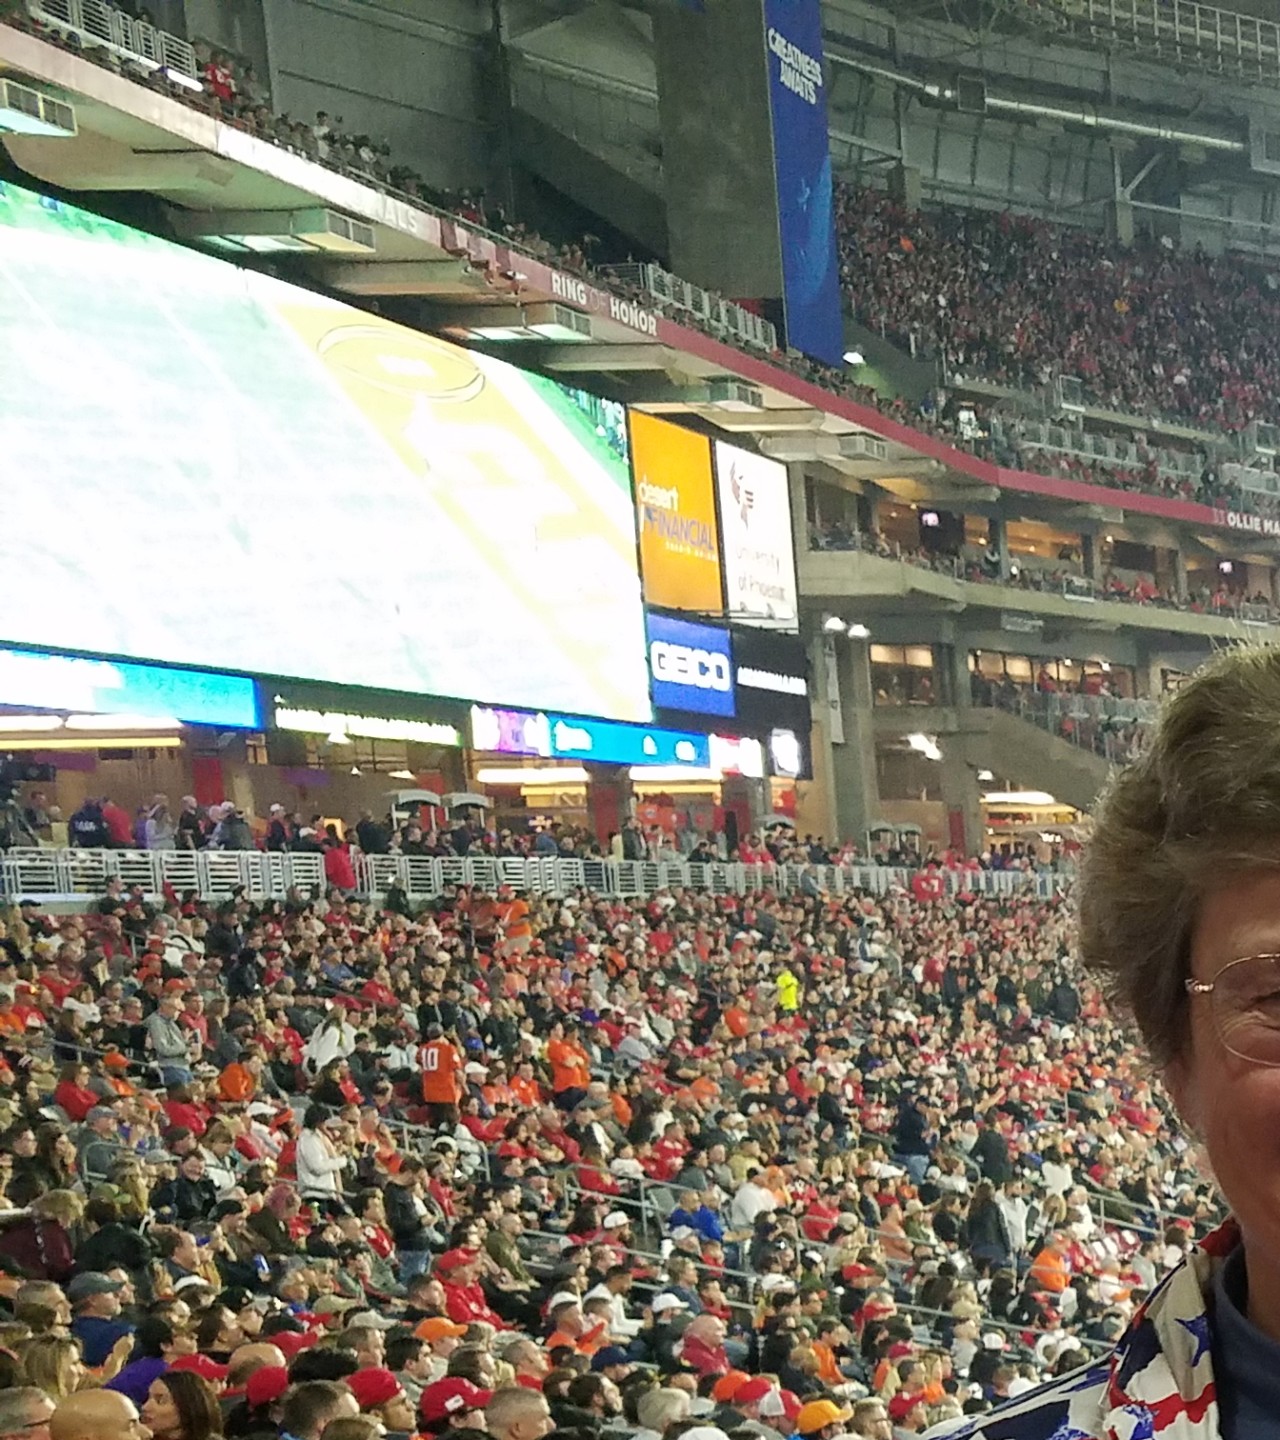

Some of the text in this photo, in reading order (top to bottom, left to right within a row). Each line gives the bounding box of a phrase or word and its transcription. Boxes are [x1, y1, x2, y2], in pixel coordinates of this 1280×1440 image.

[551, 271, 587, 305] RING
[610, 297, 657, 337] HONOR
[638, 474, 679, 512] desert
[650, 505, 714, 551] FINANCIAL
[1227, 511, 1262, 531] OLLIE
[651, 640, 731, 692] GEICO
